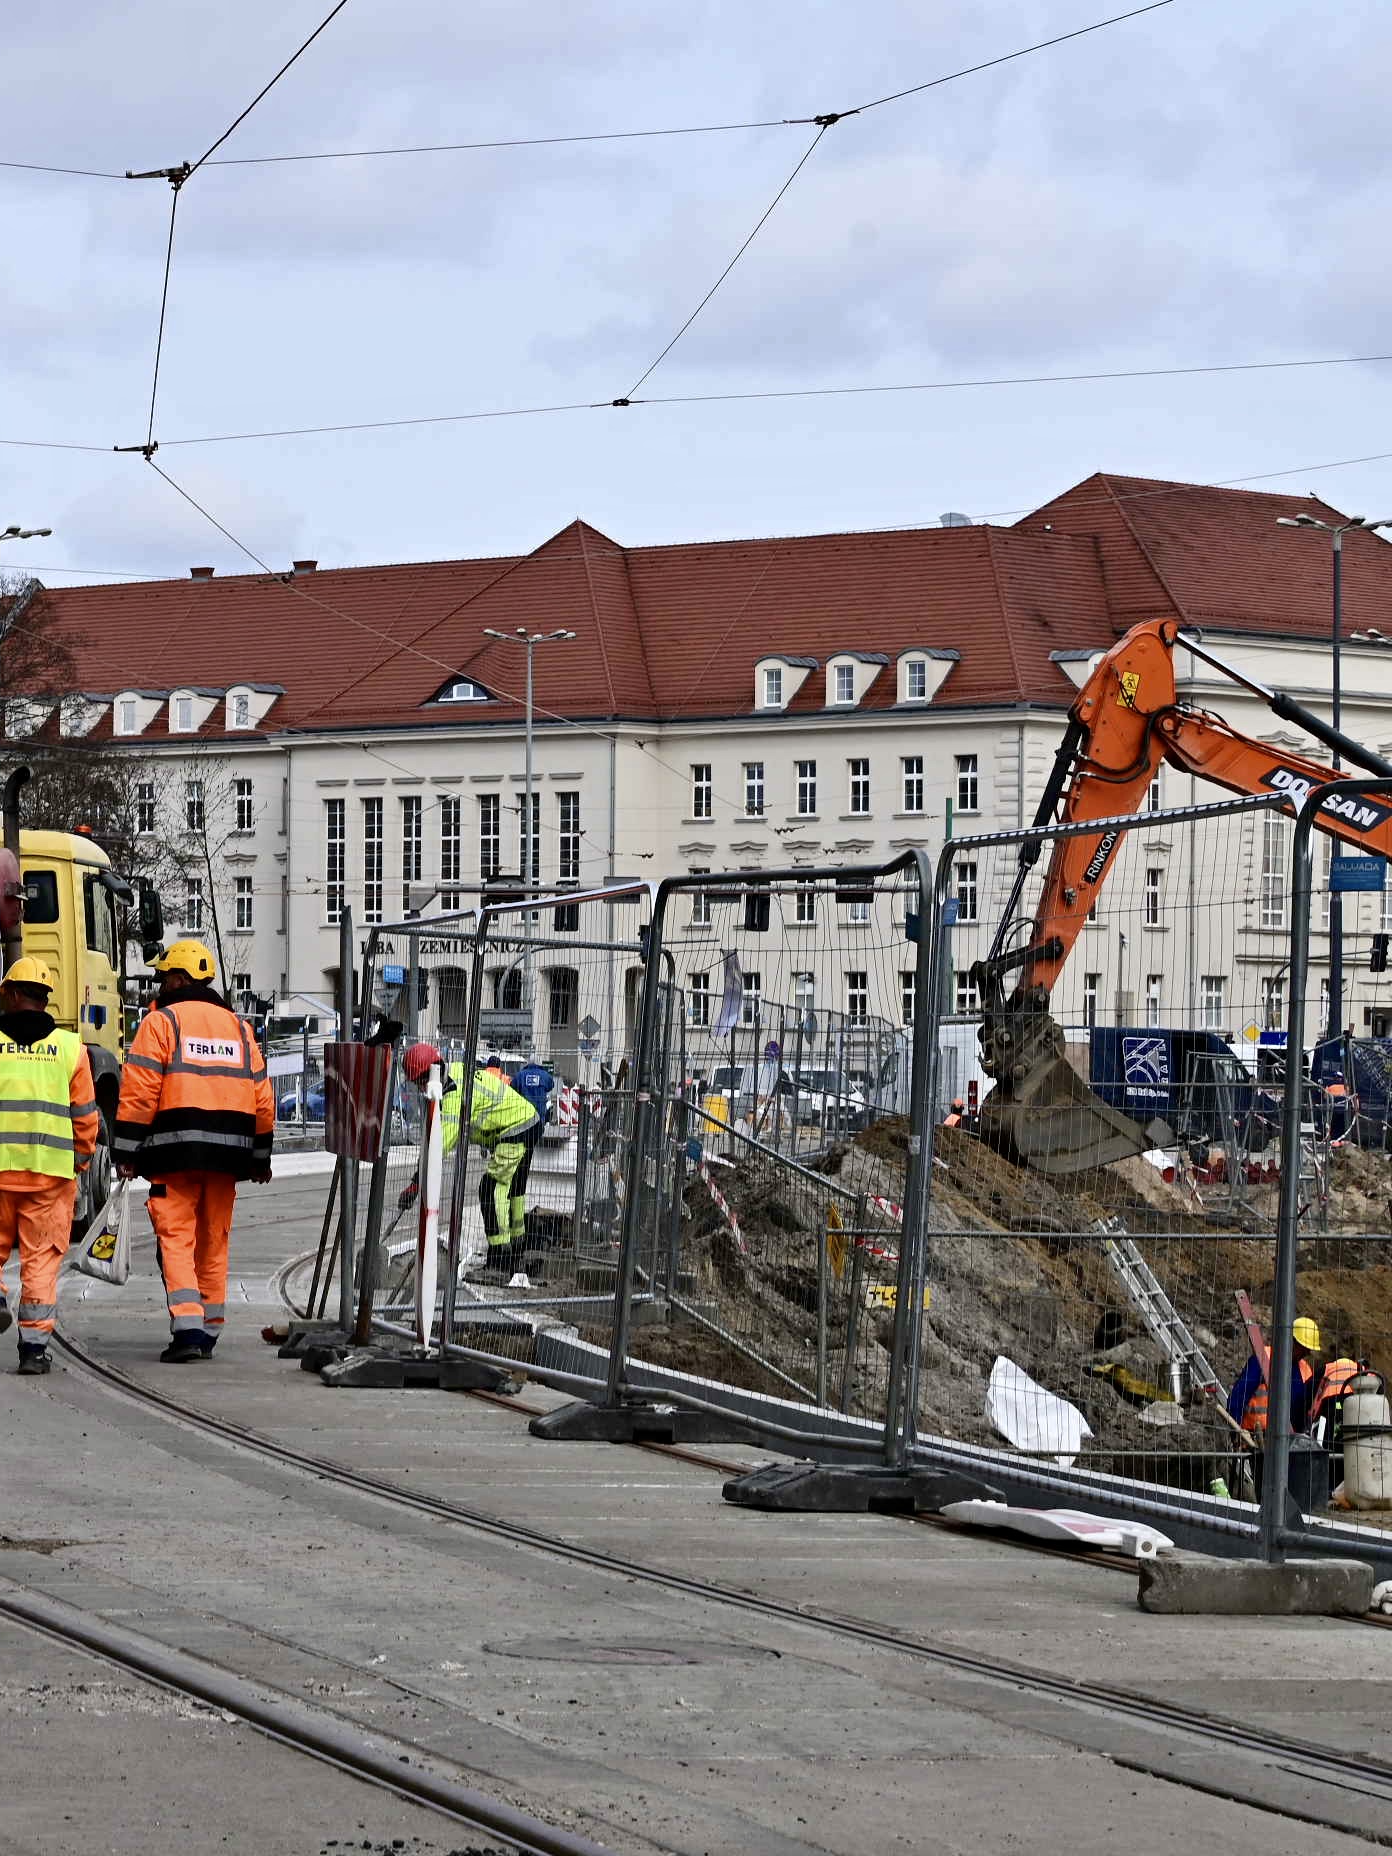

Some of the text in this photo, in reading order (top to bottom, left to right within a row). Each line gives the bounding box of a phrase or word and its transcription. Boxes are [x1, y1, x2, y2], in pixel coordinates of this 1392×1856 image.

[1270, 769, 1378, 827] DOSAN
[360, 940, 395, 954] IBA
[188, 1043, 234, 1056] TERLAN
